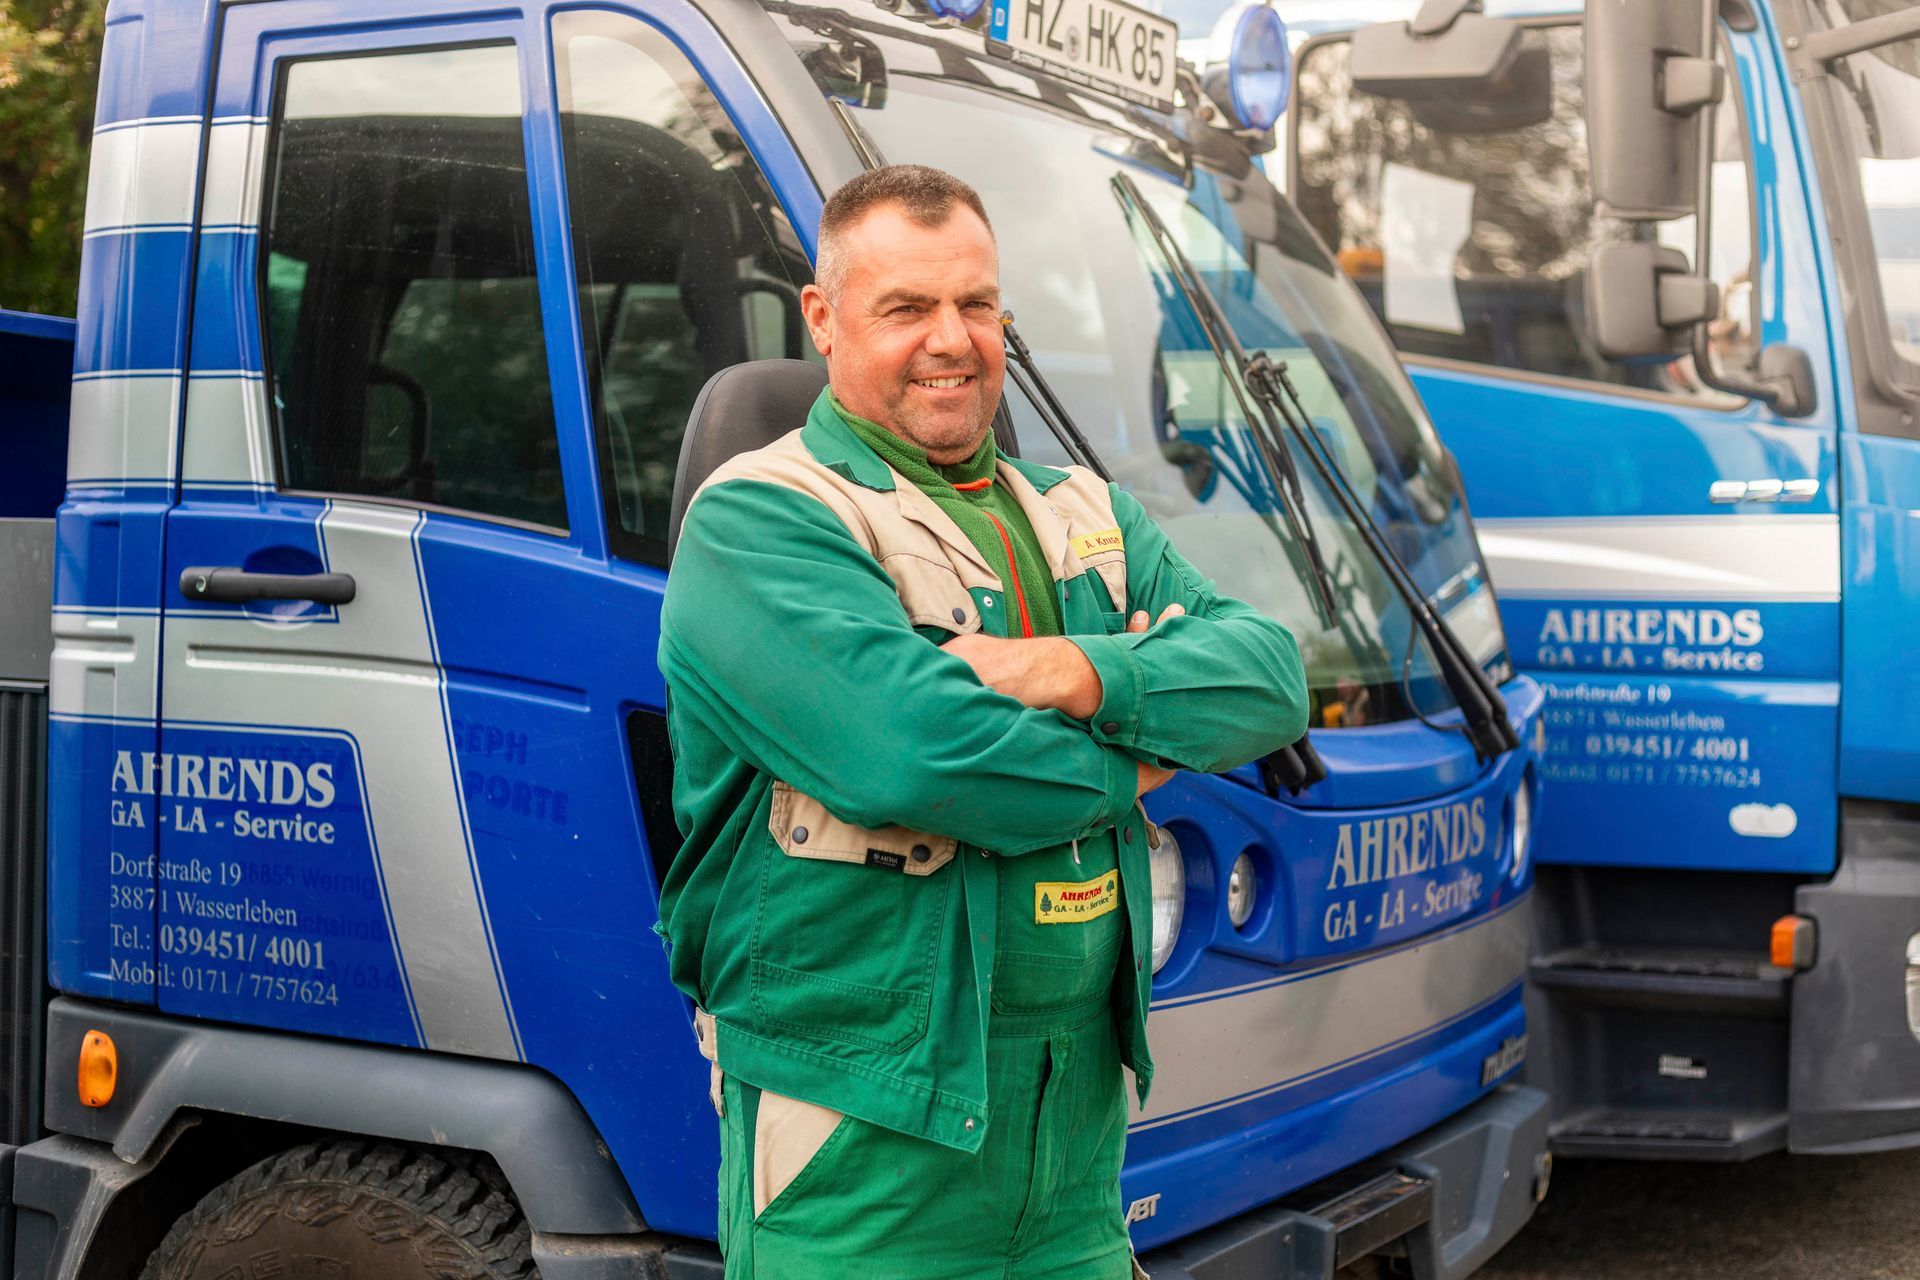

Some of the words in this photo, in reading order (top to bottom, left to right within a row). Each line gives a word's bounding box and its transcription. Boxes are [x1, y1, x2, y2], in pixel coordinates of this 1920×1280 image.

[1025, 0, 1063, 51] HZ
[1087, 4, 1124, 73] HK
[1132, 22, 1164, 86] 85
[1540, 609, 1764, 646] AHRENDS
[1538, 647, 1575, 666] GA
[1602, 647, 1636, 667] LA
[1662, 647, 1764, 671] Service
[1647, 683, 1671, 704] 19
[1691, 737, 1749, 762] 4001
[111, 750, 335, 809] AHRENDS
[111, 800, 145, 828] GA
[174, 805, 207, 834] LA
[233, 811, 335, 844] Service
[1326, 797, 1486, 890] AHRENDS
[110, 852, 212, 884] Dorfstraße
[219, 862, 242, 886] 19
[110, 885, 168, 913] 38871
[176, 890, 298, 927] Wasserleben
[1054, 905, 1067, 913] GA
[1090, 896, 1109, 910] Service
[1060, 885, 1102, 901] AHRENDS
[1324, 900, 1357, 942] GA
[1379, 889, 1405, 930] LA
[1422, 868, 1483, 918] Service
[110, 923, 151, 951] Tel.:
[264, 936, 325, 970] 4001
[110, 958, 175, 988] Mobil:
[182, 966, 227, 994] 0171
[250, 974, 339, 1006] 7757624
